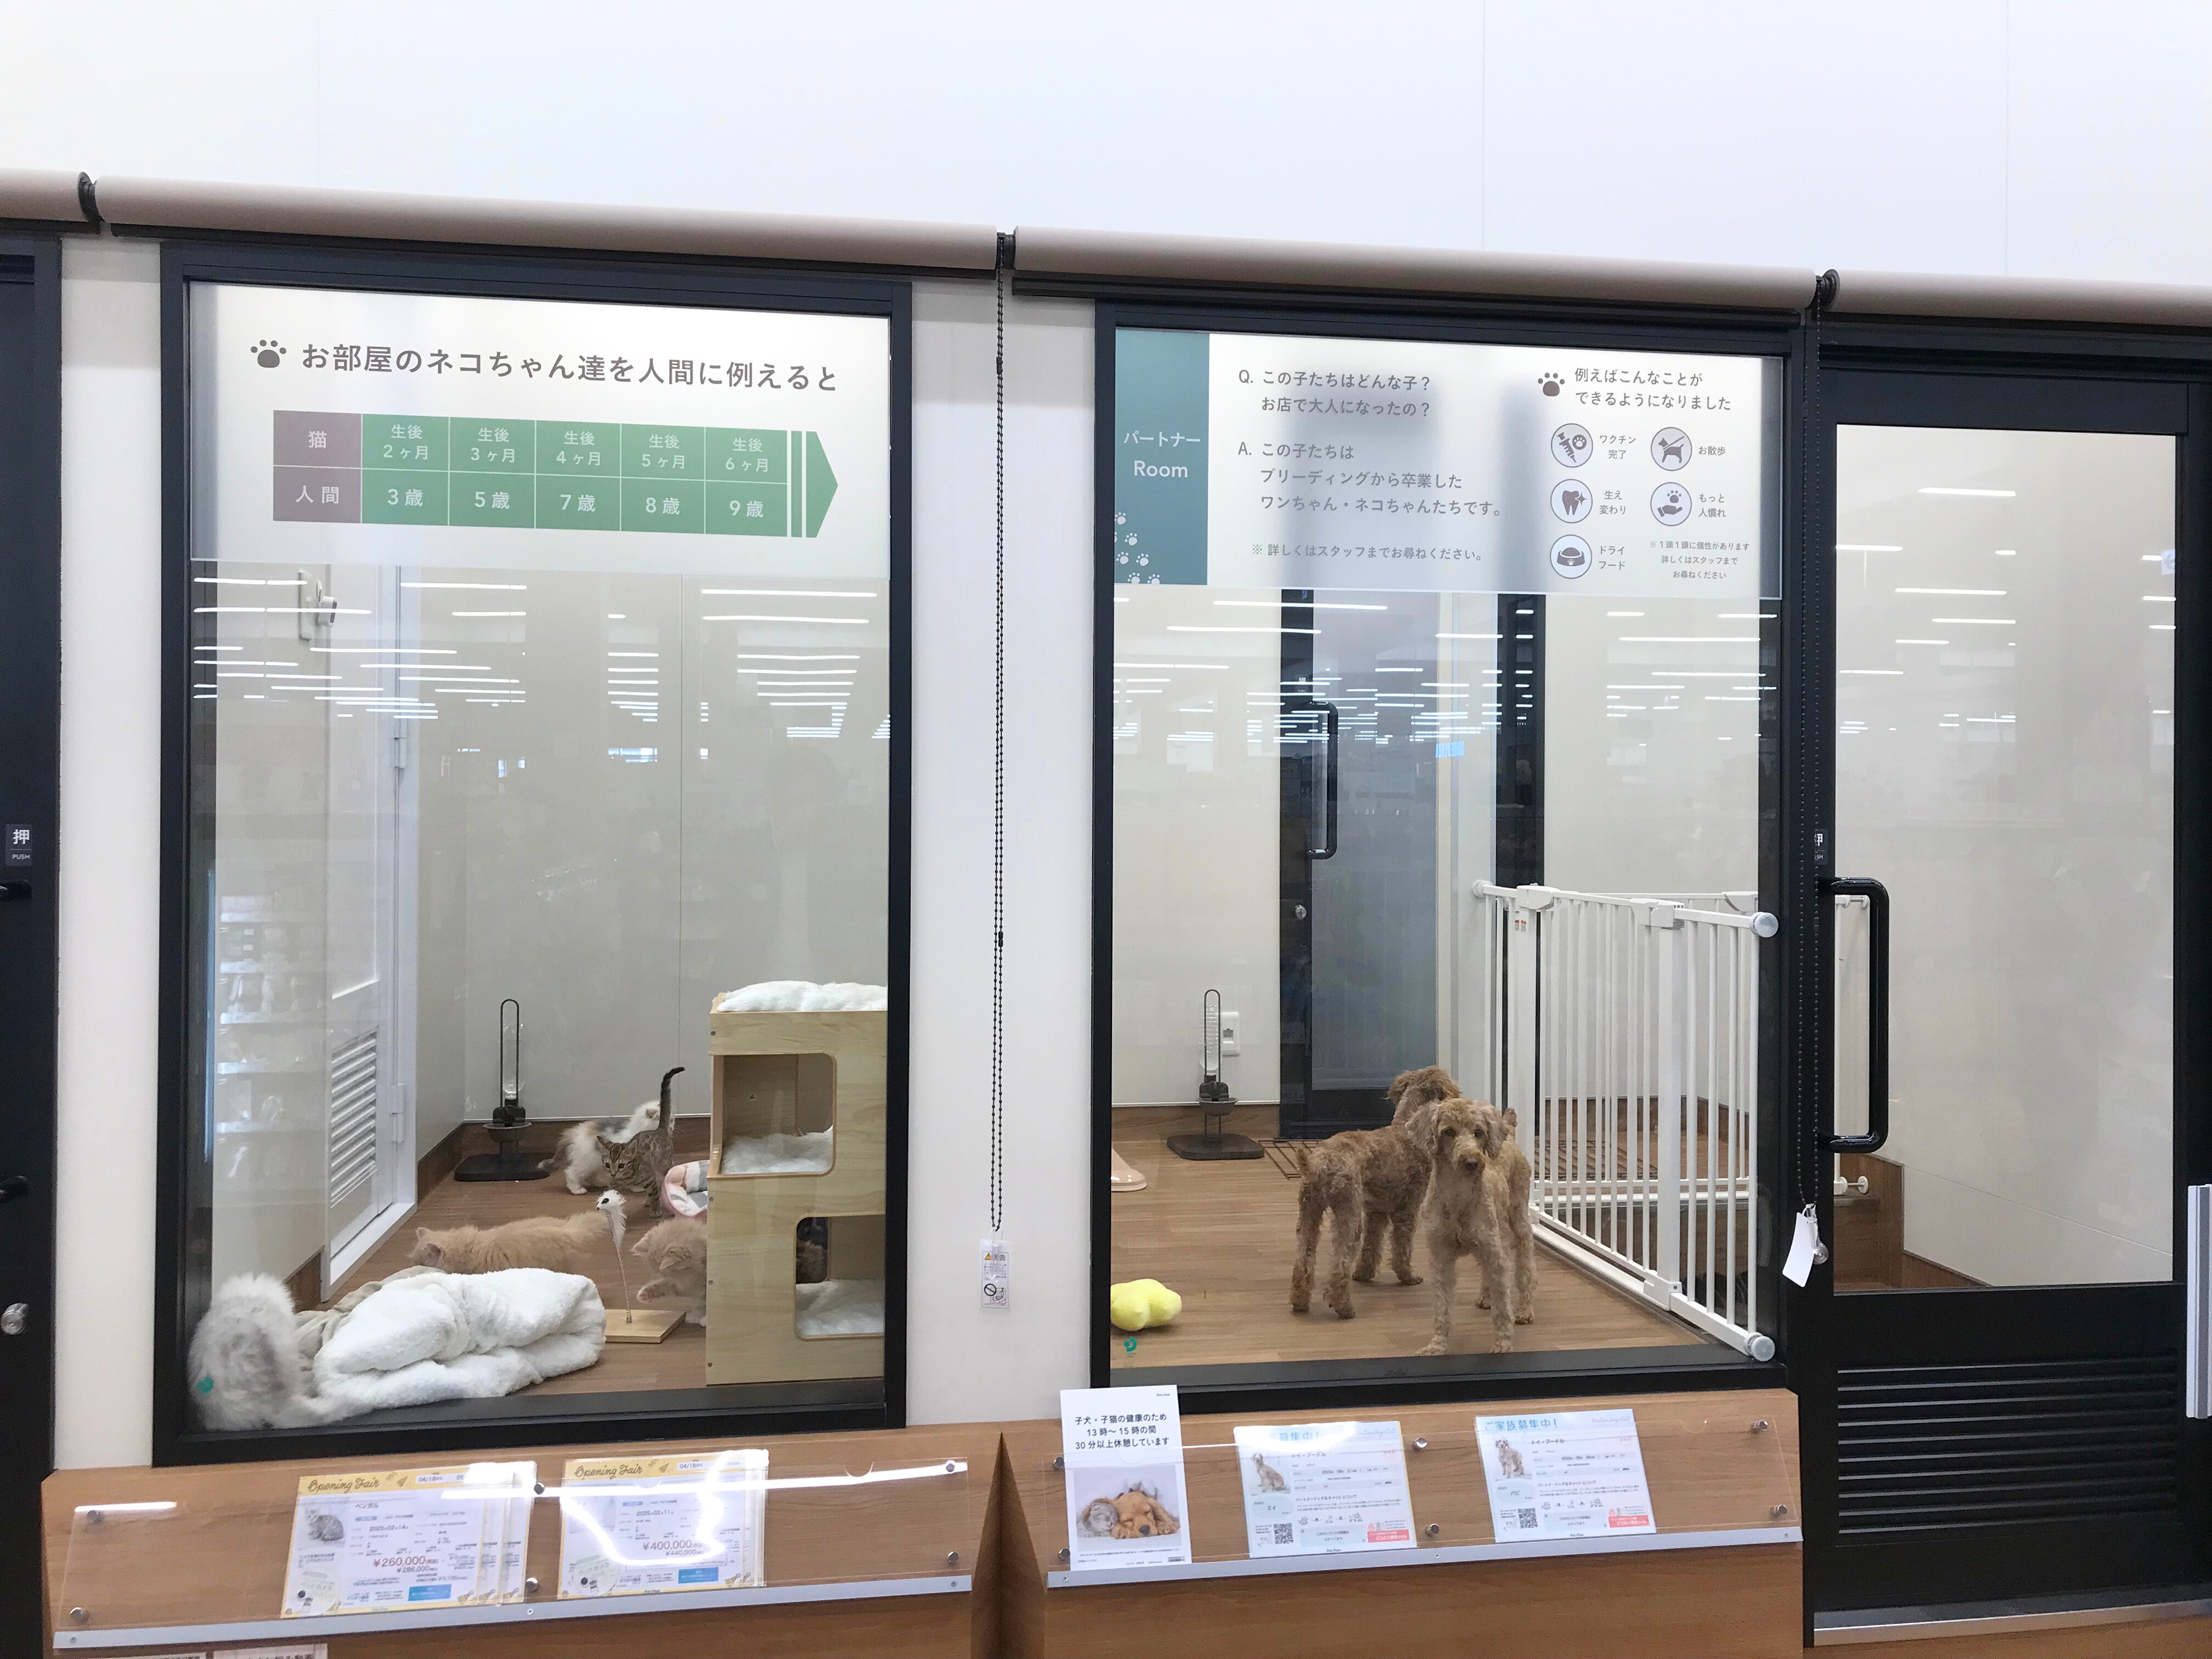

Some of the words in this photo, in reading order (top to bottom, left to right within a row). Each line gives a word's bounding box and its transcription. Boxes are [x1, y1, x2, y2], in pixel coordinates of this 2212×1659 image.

[301, 343, 837, 392] お部屋のネコちゃん達を人間に例えると
[1238, 370, 1253, 384] Q.
[1262, 370, 1430, 391] この子たちはどんな子？
[1575, 368, 1703, 386] 例えばこんなことが
[1262, 397, 1430, 417] お店で大人になったの？
[1576, 392, 1731, 410] できるようになりました
[308, 430, 327, 449] 猫
[391, 424, 422, 441] 生後
[478, 426, 509, 443] 生後
[564, 429, 594, 447] 生後
[1123, 431, 1200, 448] パートナー
[1599, 435, 1636, 444] ワクチン
[648, 433, 679, 450] 生後
[732, 436, 763, 453] 生後
[383, 444, 429, 460] 2ヶ月
[470, 447, 515, 464] 3ヶ月
[556, 450, 601, 467] 4ヶ月
[1238, 442, 1252, 455] A.
[1262, 443, 1354, 460] この子たちは
[1609, 450, 1626, 459] 完了
[1699, 445, 1726, 456] お散歩
[641, 453, 686, 470] 5ヶ月
[725, 455, 769, 473] 6ヶ月
[1134, 460, 1188, 478] Room
[1261, 469, 1462, 489] ブリーディングから卒業した
[296, 485, 339, 505] 人間
[387, 488, 423, 507] 3歳
[475, 490, 510, 510] 5歳
[560, 493, 595, 513] 7歳
[1604, 490, 1622, 500] 生え
[1700, 493, 1725, 503] もっと
[646, 495, 680, 516] 8歳
[730, 498, 763, 518] 9歳
[1261, 496, 1500, 517] ワンちゃん・ネコちゃんたちです。
[1599, 505, 1627, 515] 変わり
[1699, 508, 1726, 518] 人慣れ
[1600, 545, 1624, 555] ドライ
[1599, 560, 1625, 569] フード
[1661, 555, 1737, 565] 詳しくはスタッフまで
[1673, 570, 1726, 579] お尋ねください
[13, 829, 29, 844] 押
[1075, 1413, 1167, 1425] 子犬・子猫の健康のため
[1075, 1437, 1169, 1449] 30分以上休憩しています
[574, 1466, 617, 1480] Opening
[619, 1464, 642, 1476] Fair
[308, 1479, 352, 1494] Opening
[642, 1540, 691, 1551] ¥400,000
